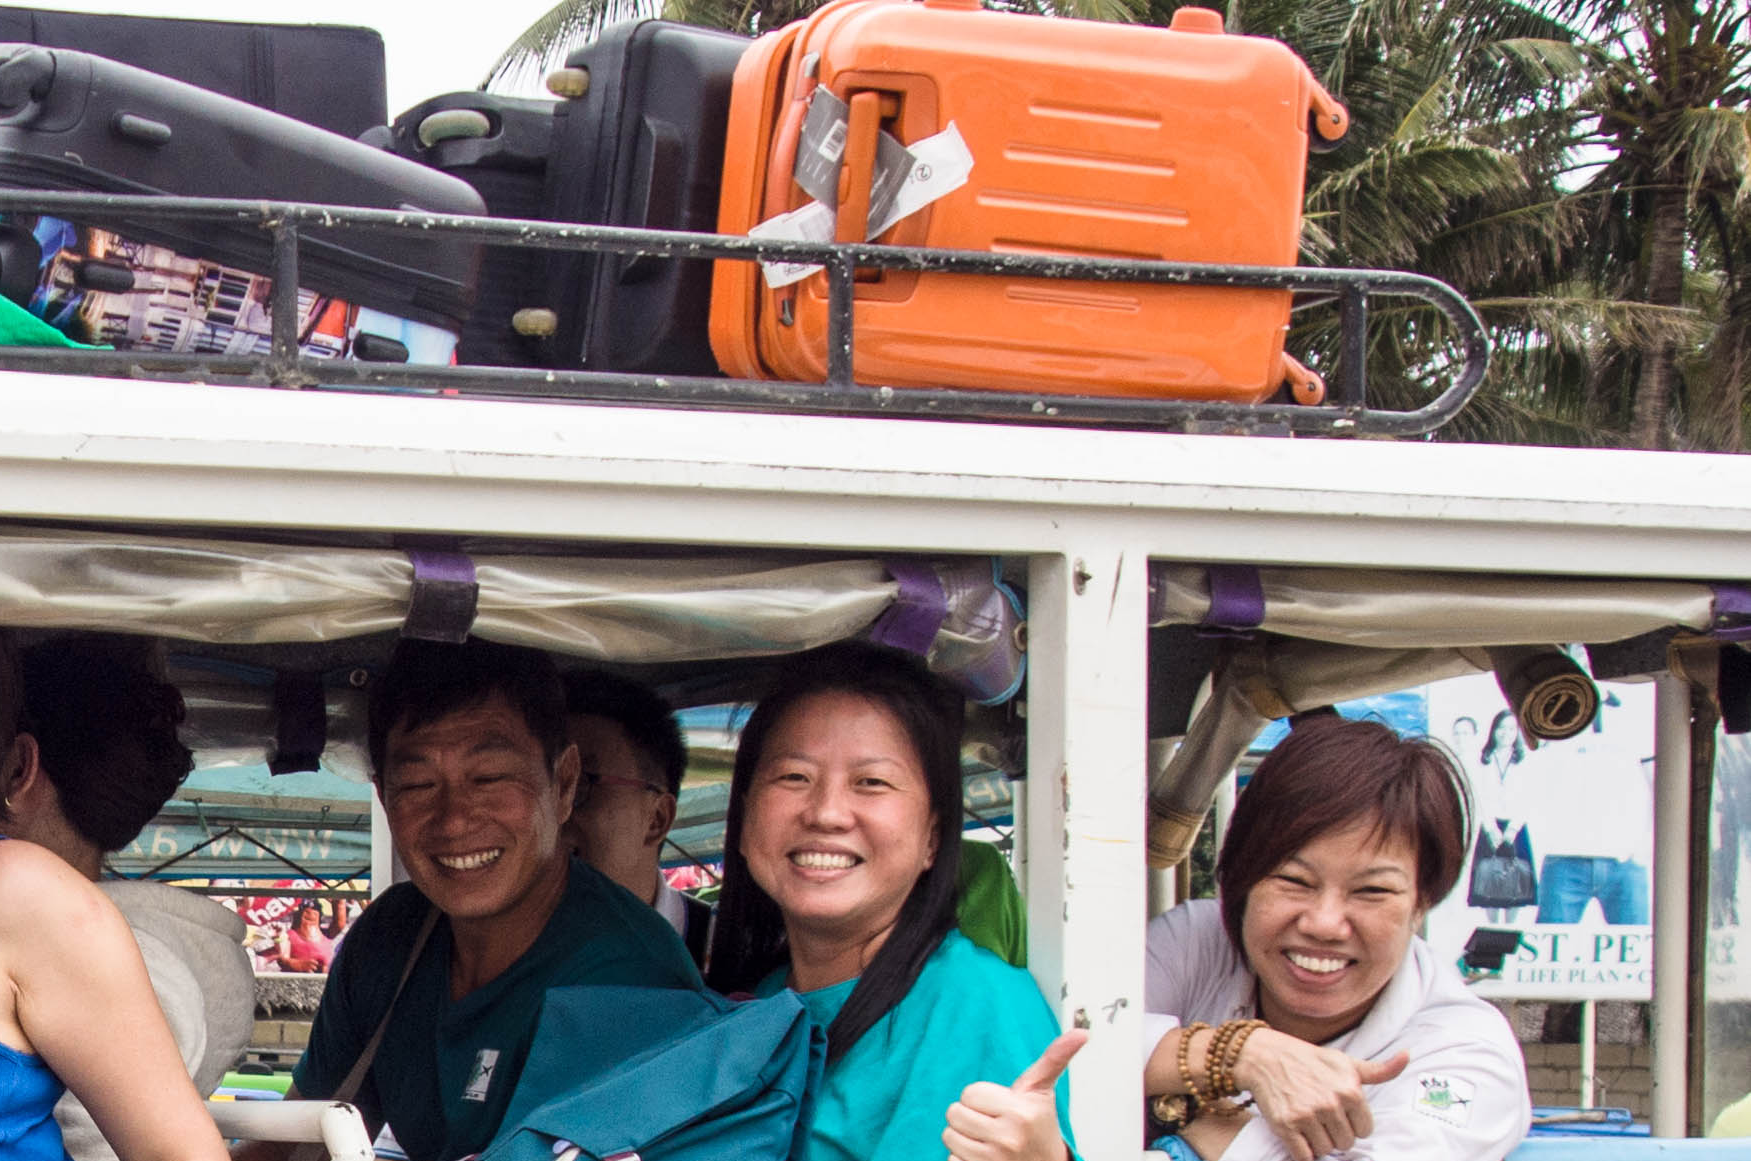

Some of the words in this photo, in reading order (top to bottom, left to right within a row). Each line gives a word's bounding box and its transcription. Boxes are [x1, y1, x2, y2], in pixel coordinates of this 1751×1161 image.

[1591, 933, 1653, 964] PE
[1516, 967, 1562, 984] LIFE
[1568, 967, 1620, 984] PLAN
